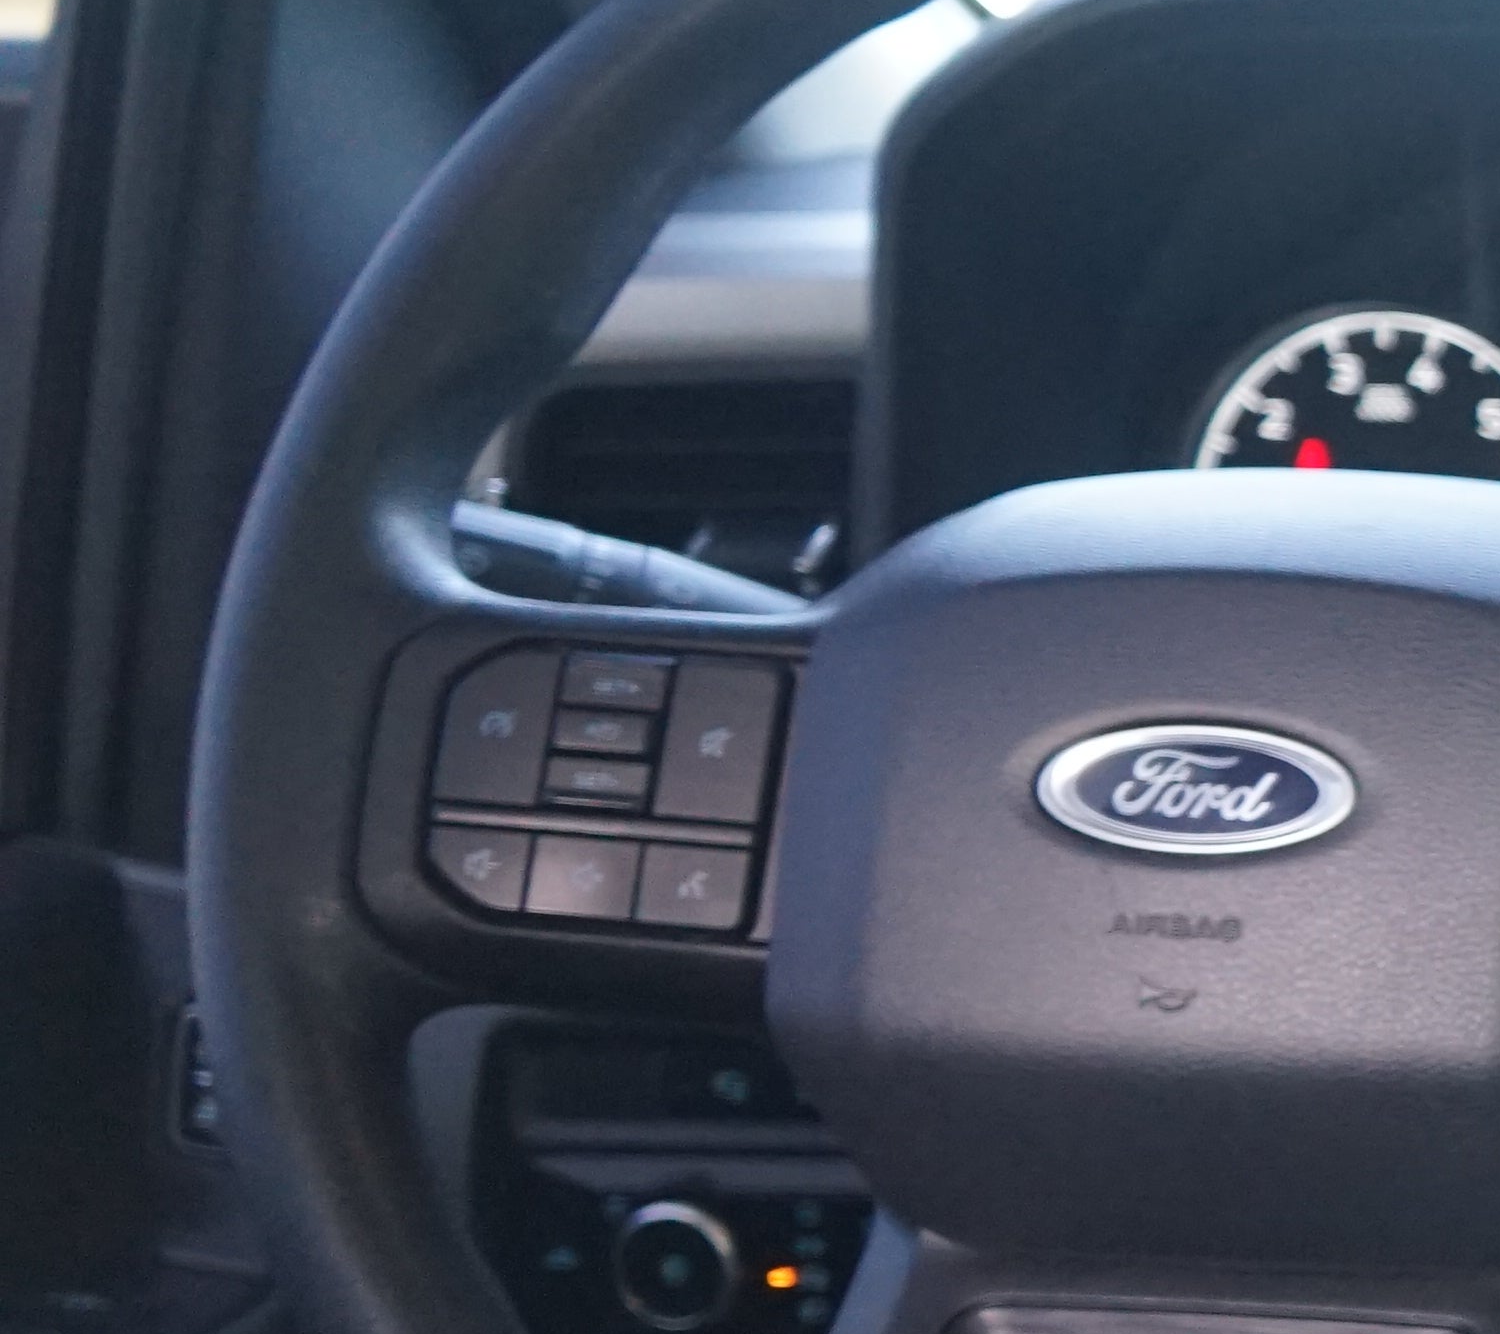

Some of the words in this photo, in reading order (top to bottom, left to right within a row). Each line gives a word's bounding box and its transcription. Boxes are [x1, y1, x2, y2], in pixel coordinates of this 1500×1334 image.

[1327, 352, 1367, 396] 3
[1405, 351, 1448, 395] 4
[1111, 748, 1282, 823] Ford
[1110, 912, 1243, 943] AIRBAG
